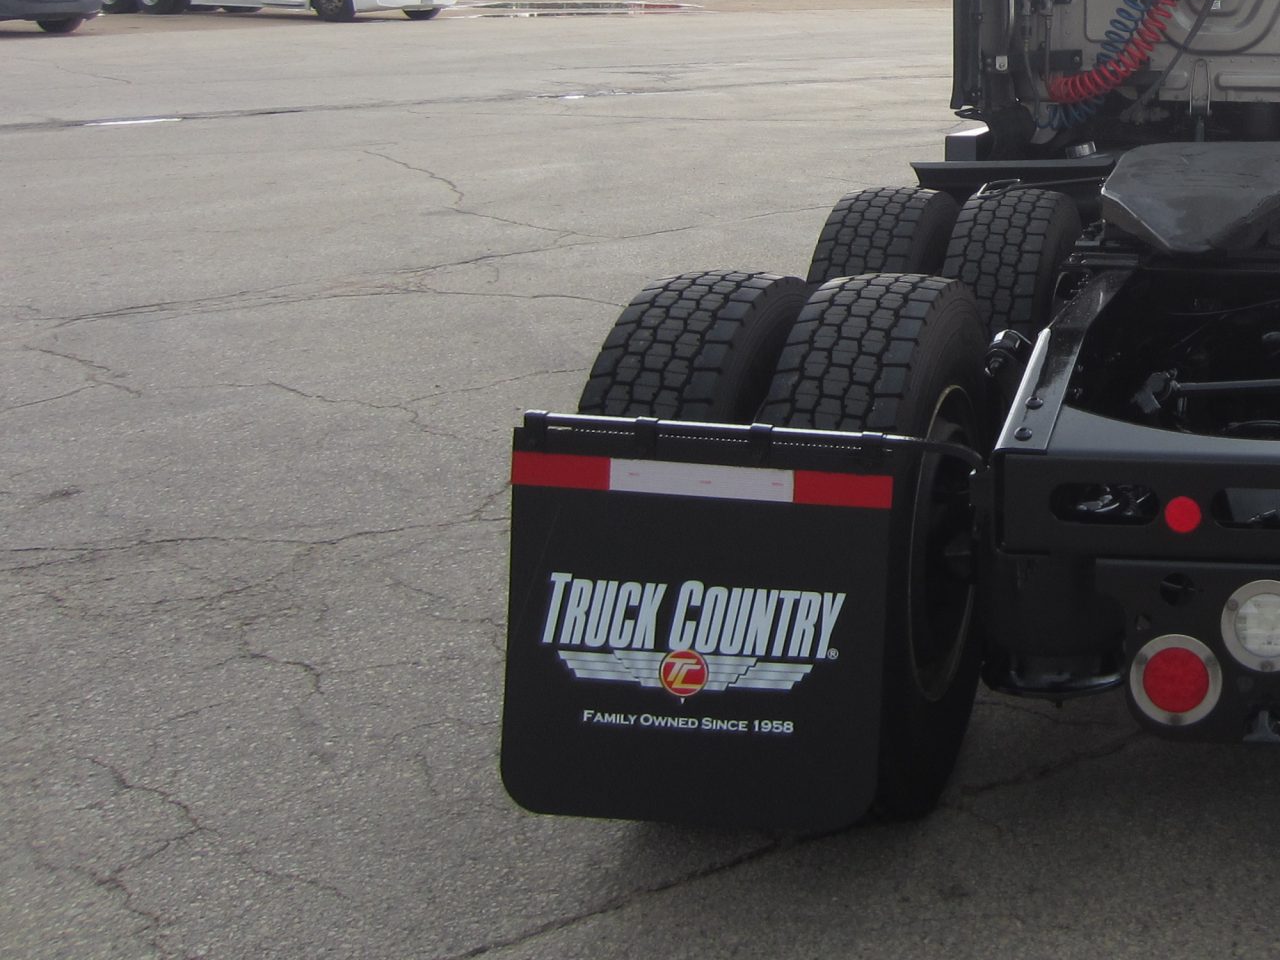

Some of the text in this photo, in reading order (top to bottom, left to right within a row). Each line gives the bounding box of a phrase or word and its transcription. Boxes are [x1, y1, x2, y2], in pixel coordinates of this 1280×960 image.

[542, 572, 847, 659] TRUCK COUNTRY
[582, 709, 795, 734] FAMILY OWNED SINCE 1958
